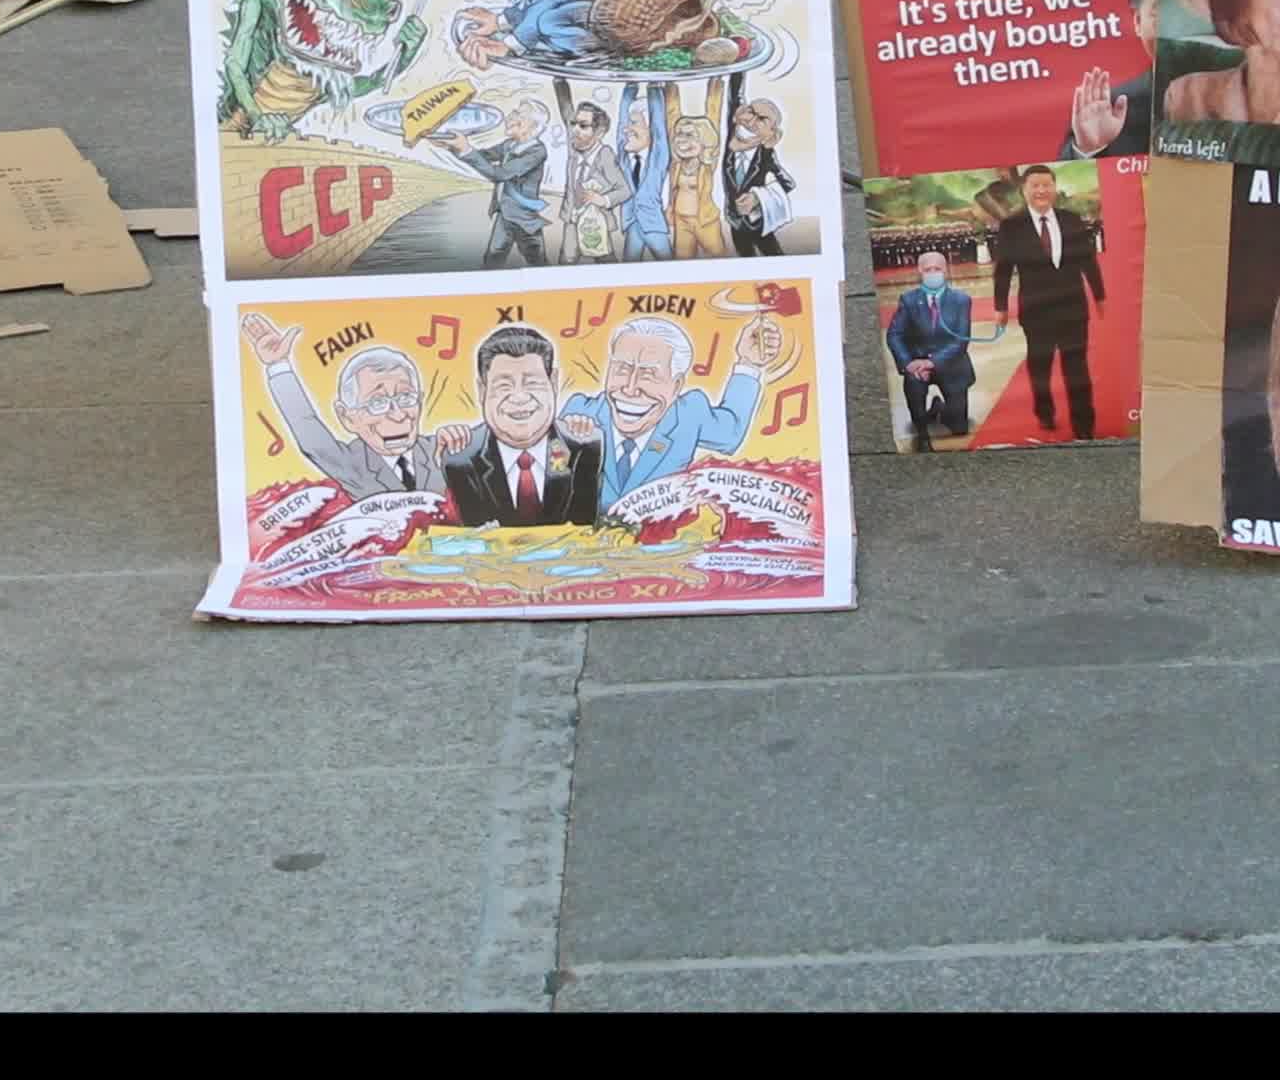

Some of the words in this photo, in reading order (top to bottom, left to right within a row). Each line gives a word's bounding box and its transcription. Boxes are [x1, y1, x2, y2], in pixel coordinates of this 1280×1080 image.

[877, 24, 996, 63] already
[1006, 14, 1122, 51] bought
[953, 57, 1050, 87] them.
[405, 82, 461, 125] TAIWAN
[1158, 137, 1193, 155] hard
[1197, 139, 1227, 160] left!
[1249, 169, 1272, 204] A
[258, 164, 395, 261] CCP
[495, 304, 526, 325] XI
[627, 293, 697, 319] XIDEN
[312, 320, 376, 368] FAUXI
[621, 486, 656, 511] DEATH
[658, 481, 673, 496] BY
[634, 492, 682, 518] VACCINE
[707, 471, 813, 507] CHINESE-STYLE
[258, 491, 313, 532] BRIBERY
[359, 500, 384, 517] GUN
[384, 495, 428, 513] CONTROL
[729, 489, 812, 525] SOCIALISM
[487, 588, 616, 607] SHINING
